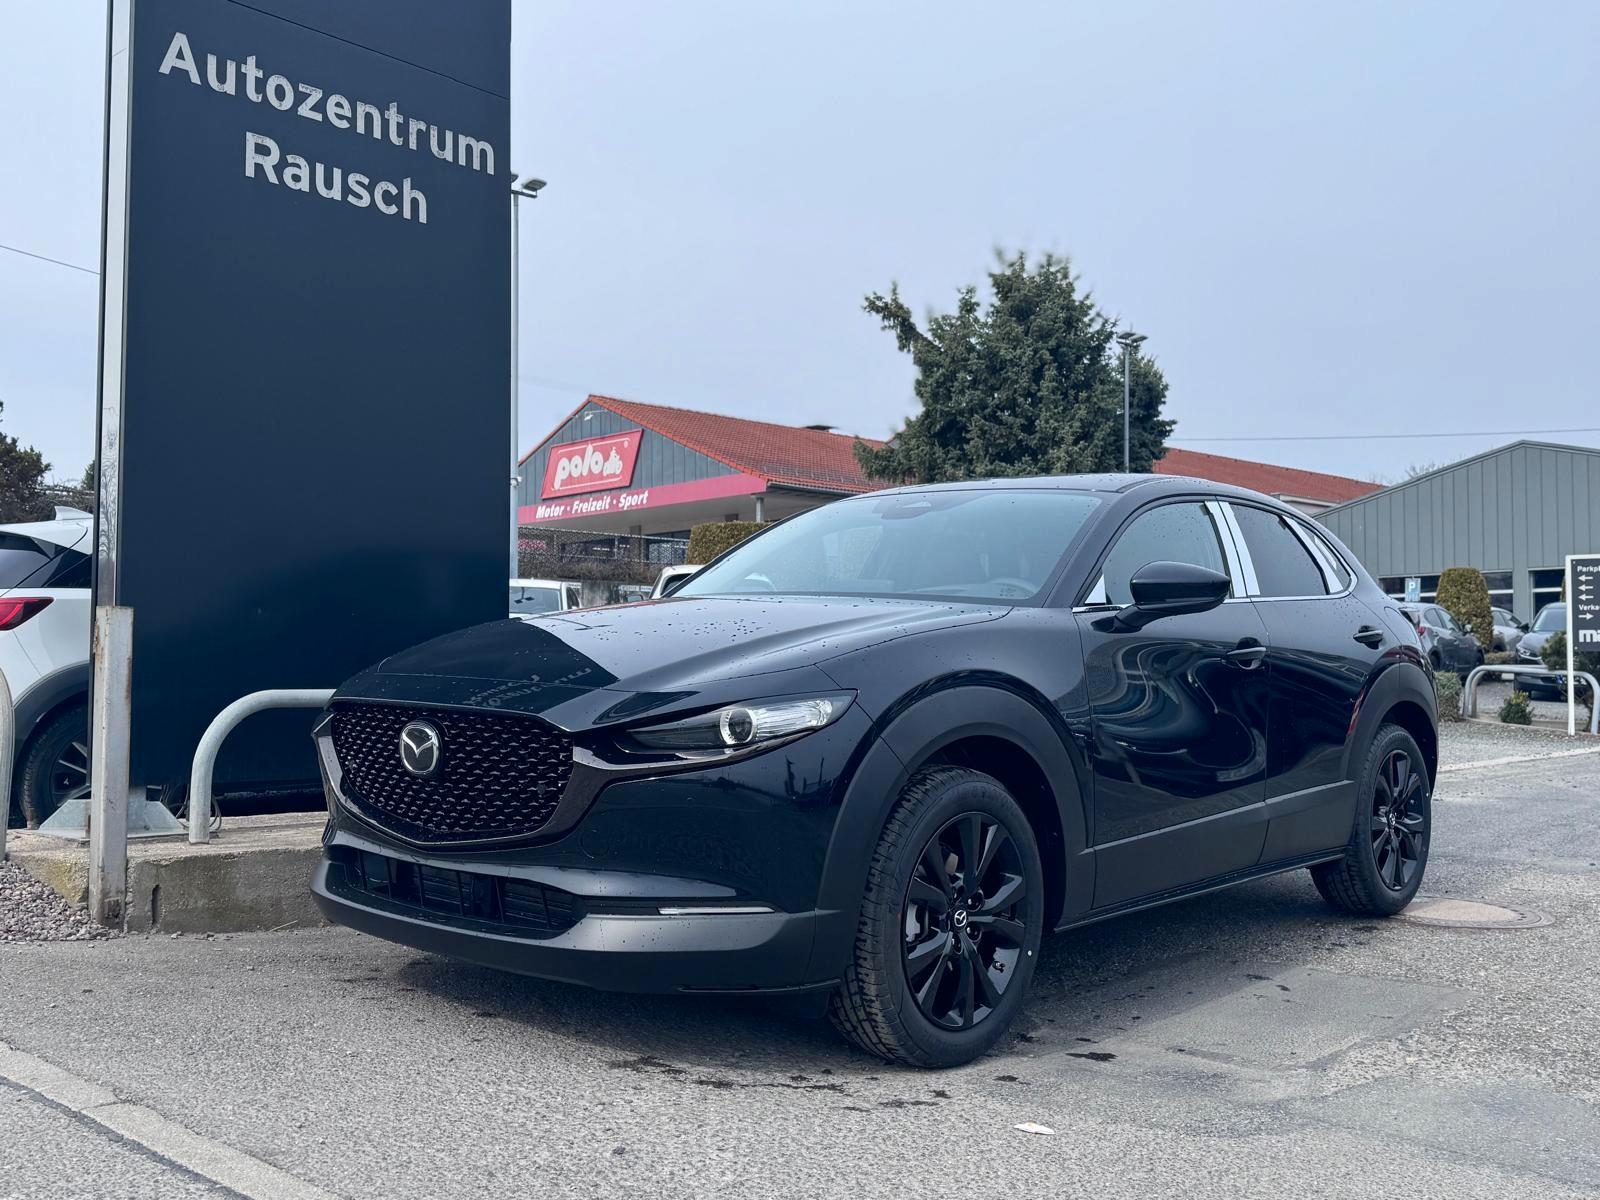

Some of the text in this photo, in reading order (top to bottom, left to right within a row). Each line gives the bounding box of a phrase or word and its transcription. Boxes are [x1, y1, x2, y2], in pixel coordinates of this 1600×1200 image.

[159, 32, 494, 175] Autozentrum
[246, 132, 427, 224] Rausch
[554, 442, 604, 490] polo
[536, 491, 649, 519] Motor Freizeit Sport
[1409, 582, 1416, 592] P
